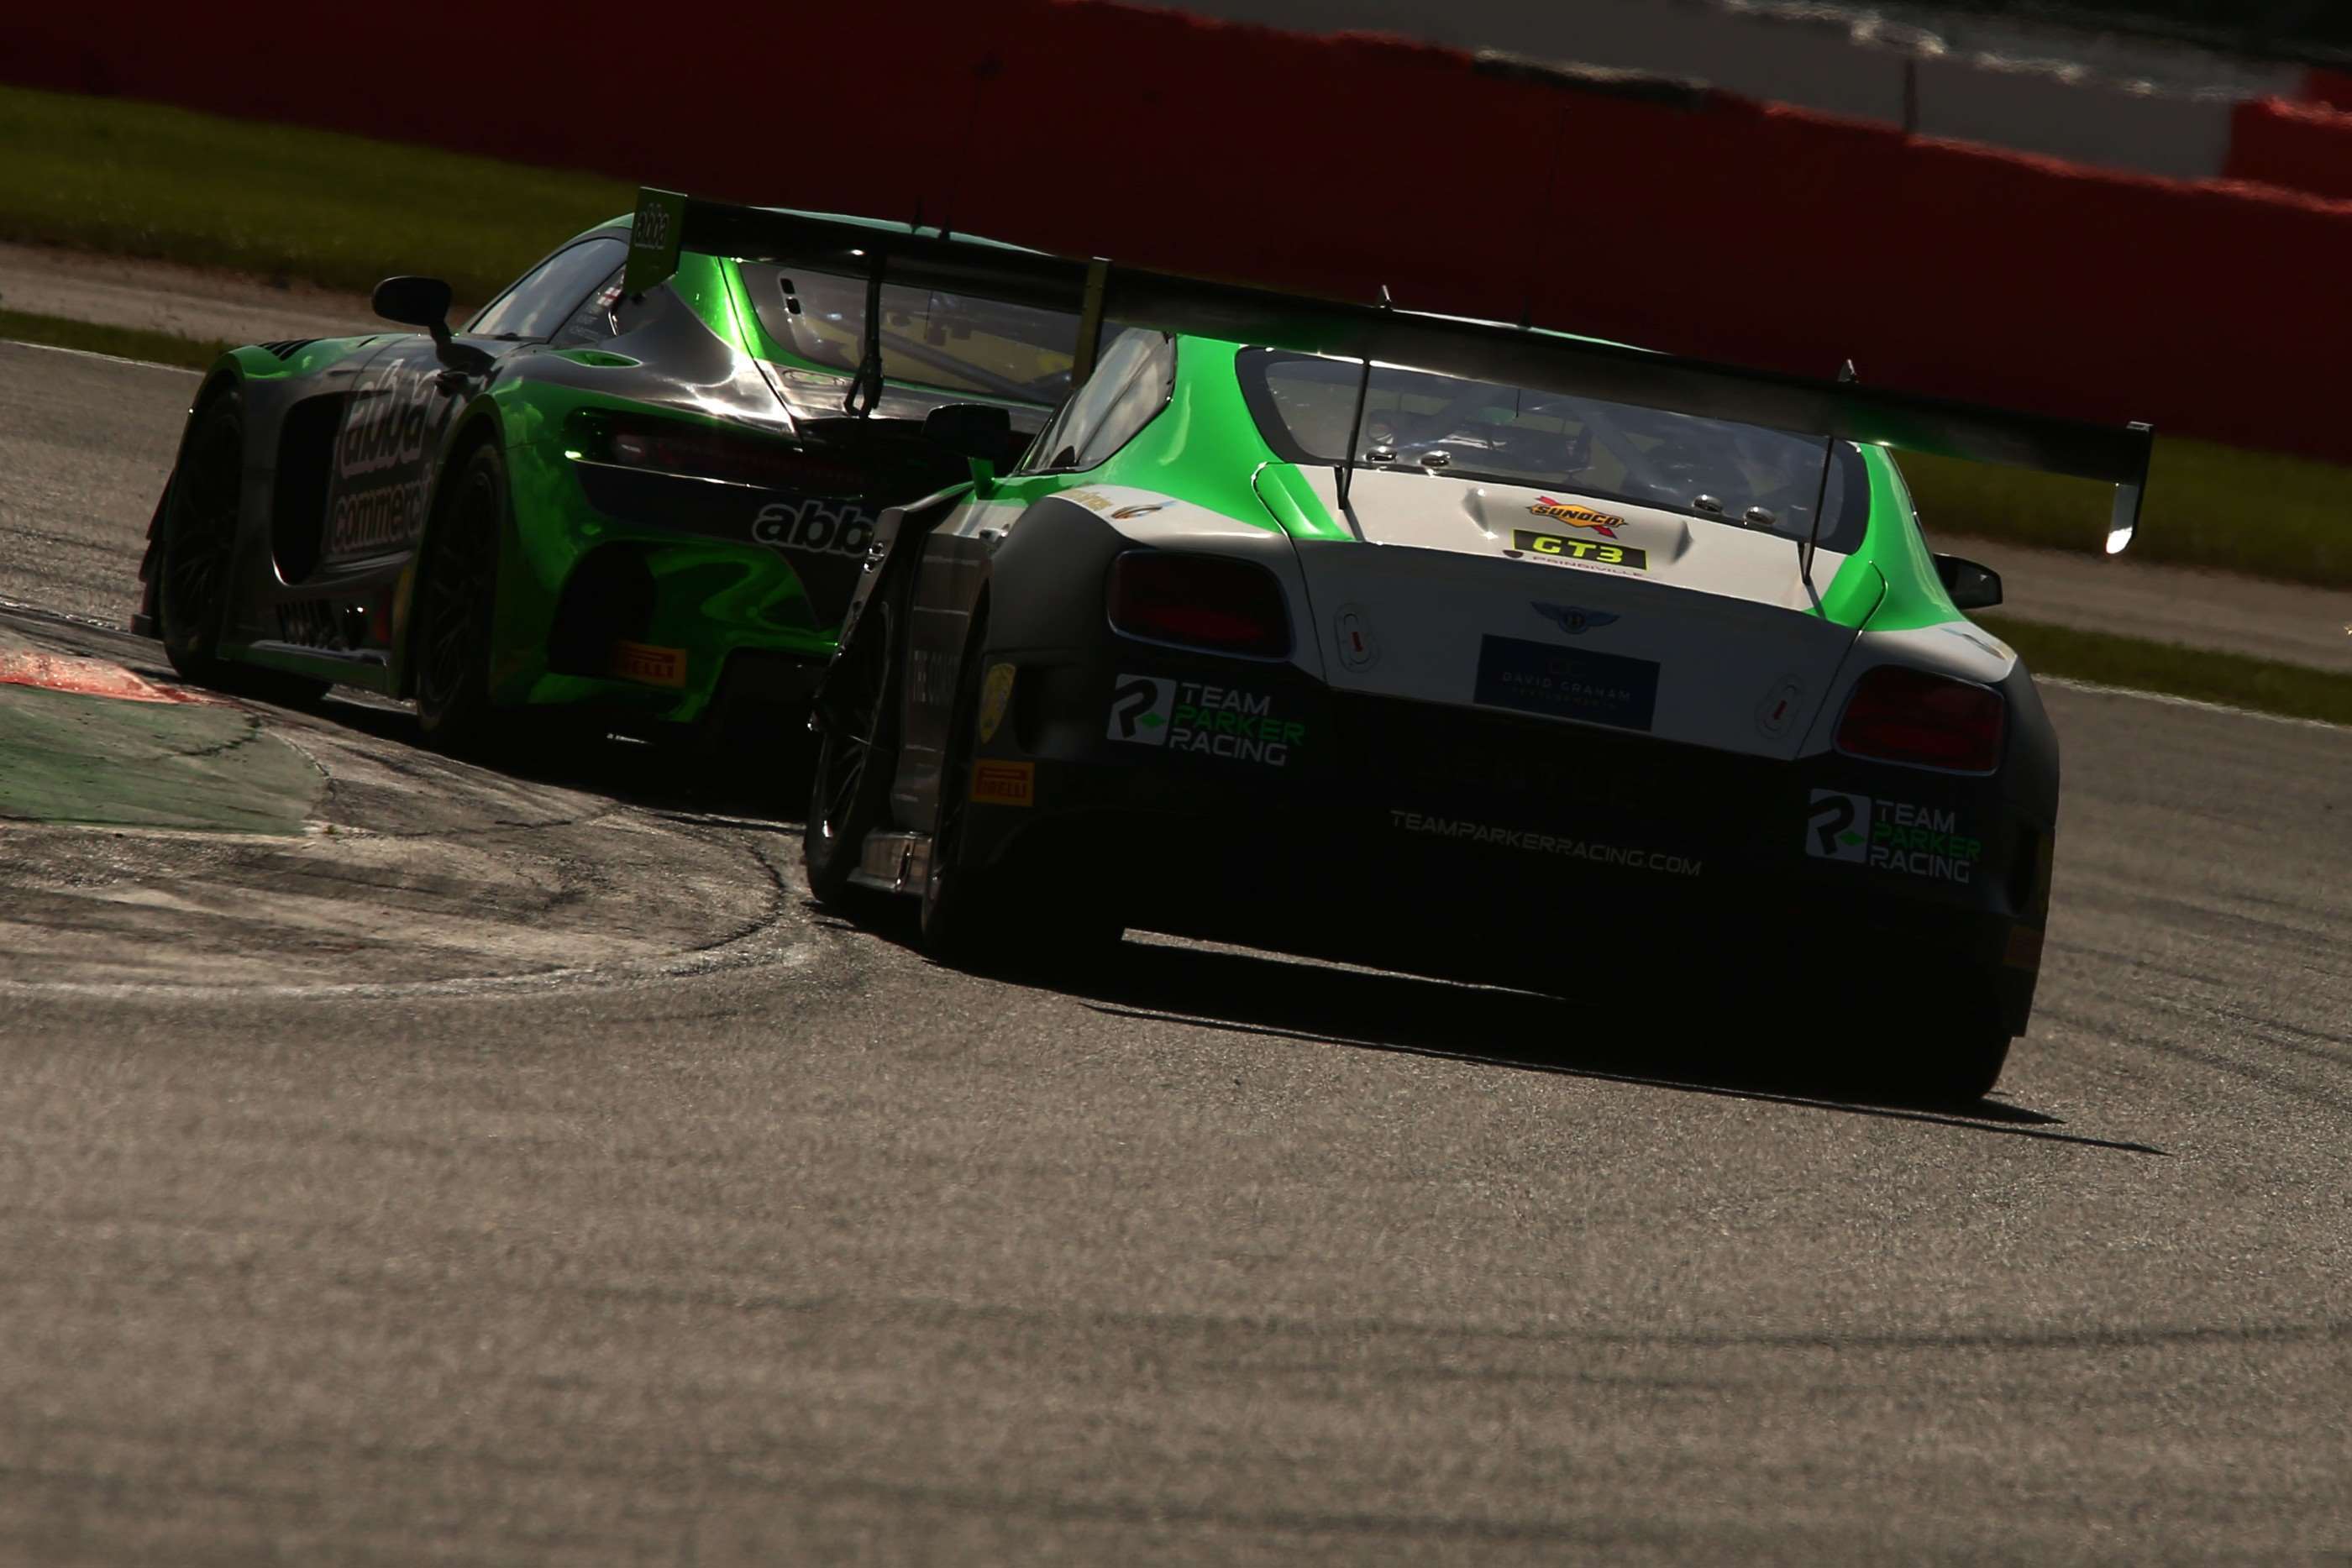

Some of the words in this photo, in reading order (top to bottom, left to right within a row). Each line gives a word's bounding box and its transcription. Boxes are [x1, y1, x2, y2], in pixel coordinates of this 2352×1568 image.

[1536, 505, 1622, 527] SUNOCO
[1531, 535, 1625, 564] GT3
[1178, 681, 1271, 716] TEAM
[1501, 671, 1553, 689] DAVID
[1560, 680, 1632, 702] GRAHAM
[1170, 705, 1308, 747] PARKER
[1168, 727, 1290, 768] RACING
[1873, 799, 1956, 835] TEAM
[1389, 808, 1703, 878] TEAMPARKERRACING.COM
[1872, 822, 1982, 862] PARKER
[1868, 846, 1971, 884] RACING
